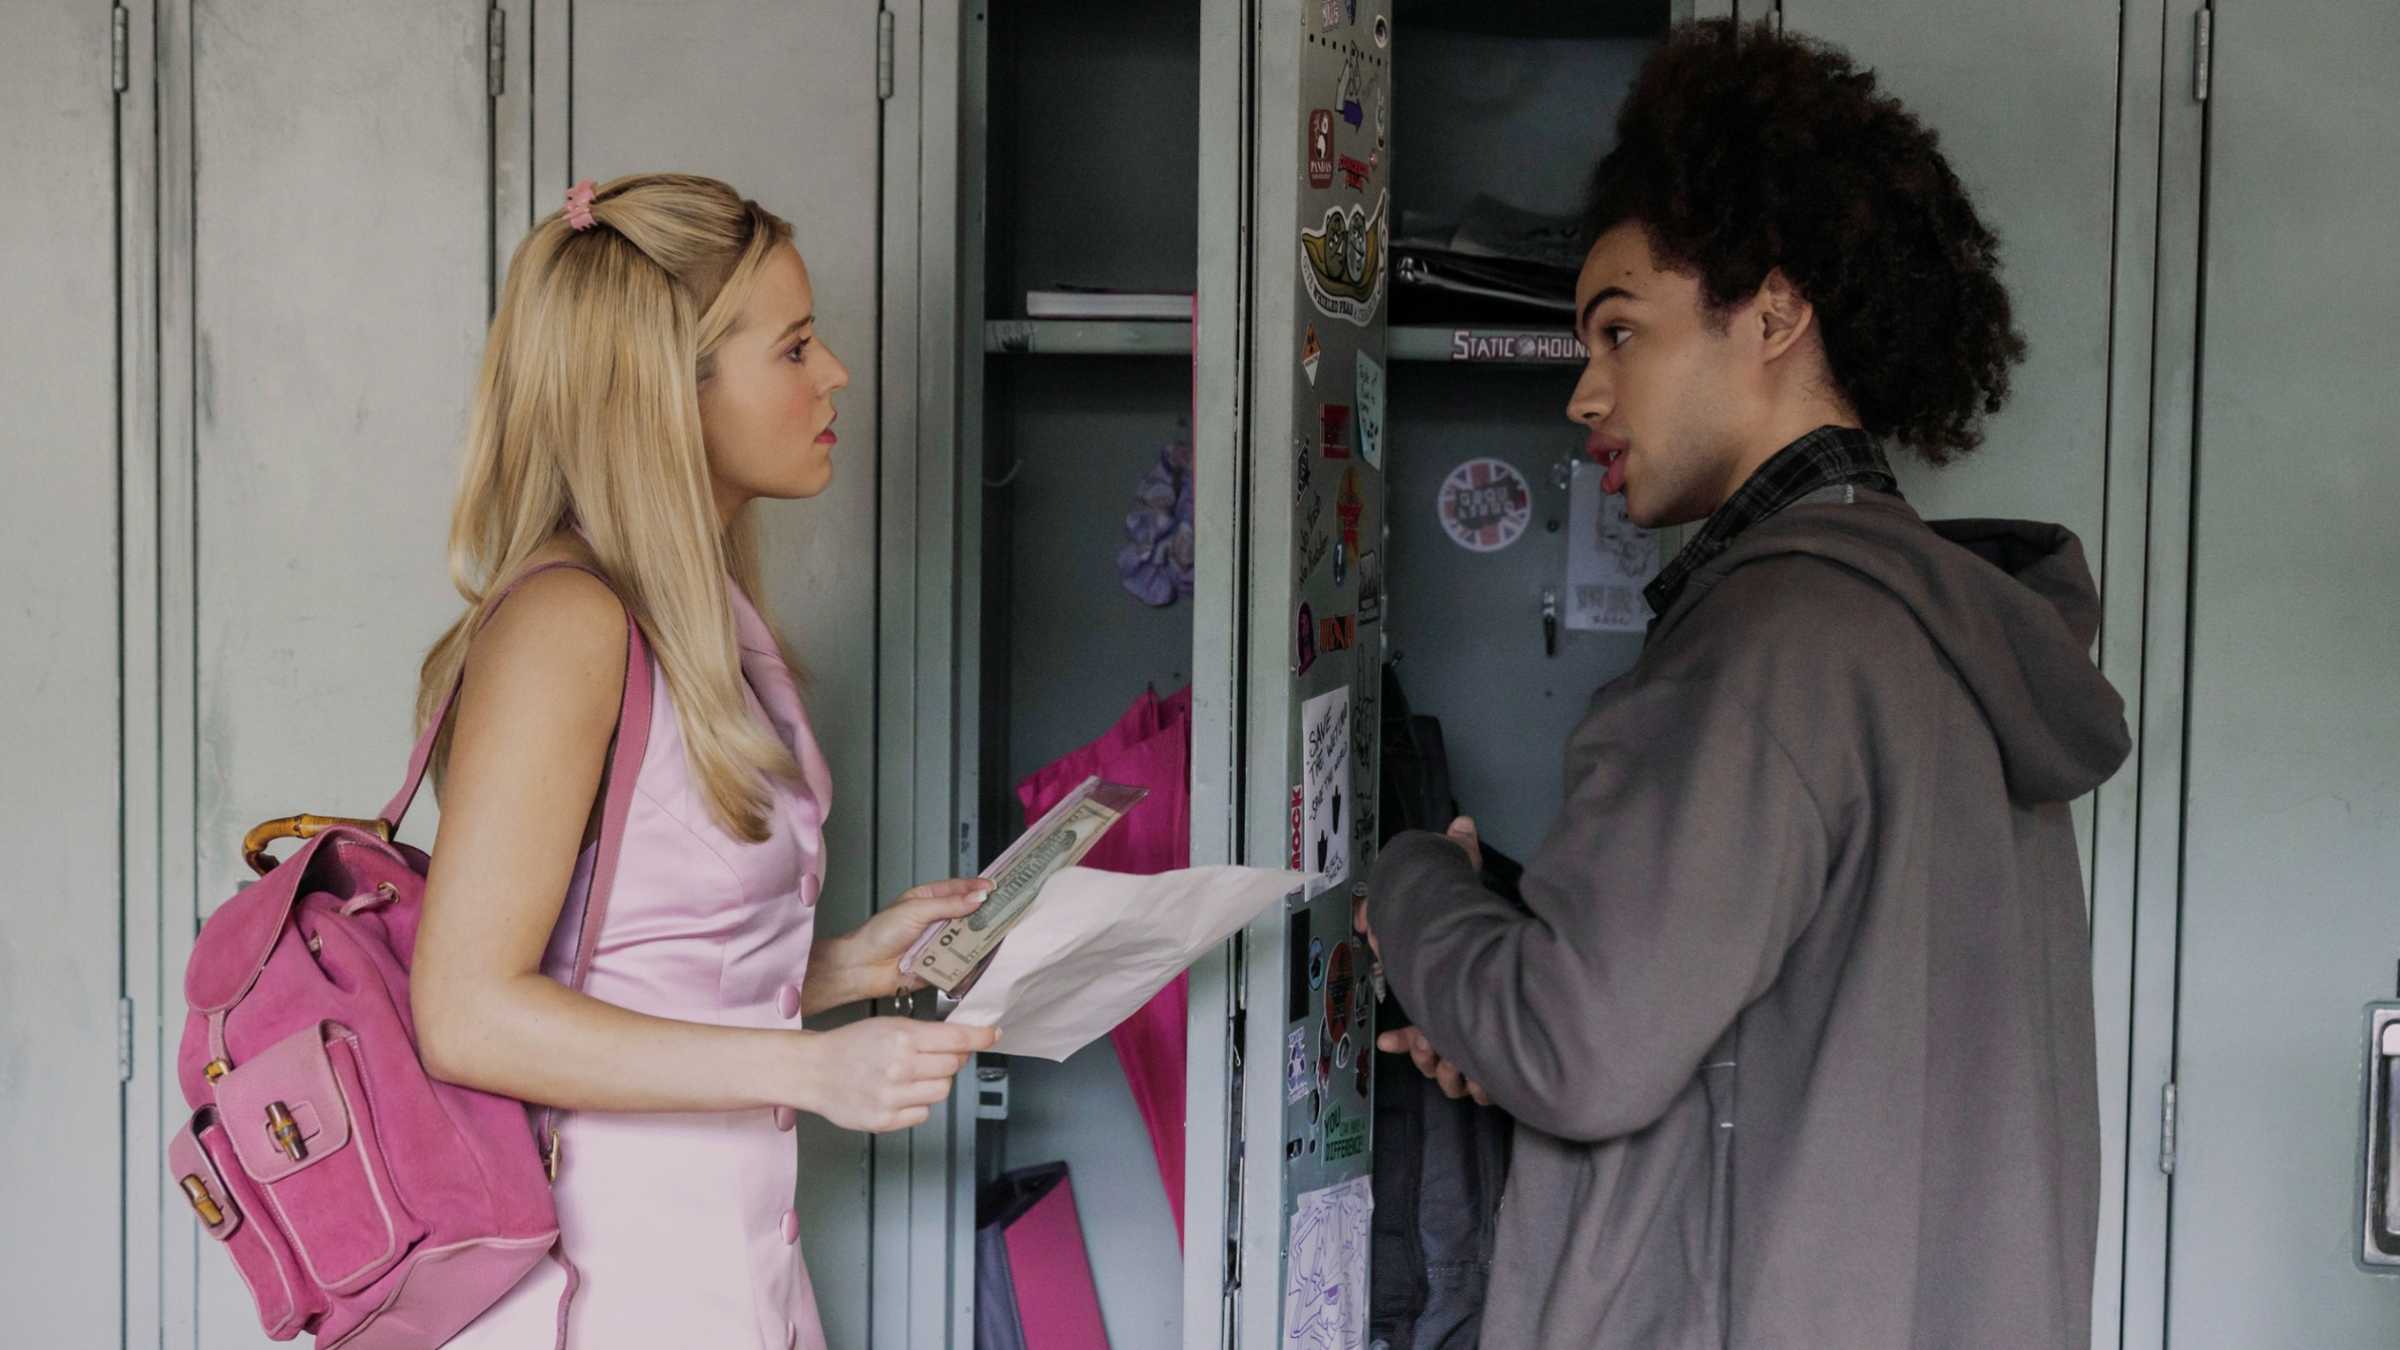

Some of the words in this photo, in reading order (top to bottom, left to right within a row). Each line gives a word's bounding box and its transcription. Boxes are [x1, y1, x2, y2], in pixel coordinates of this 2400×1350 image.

[1453, 331, 1515, 360] STATIC
[1537, 337, 1590, 359] HOUN
[1309, 705, 1332, 758] SAVE
[1324, 1104, 1341, 1139] YOU
